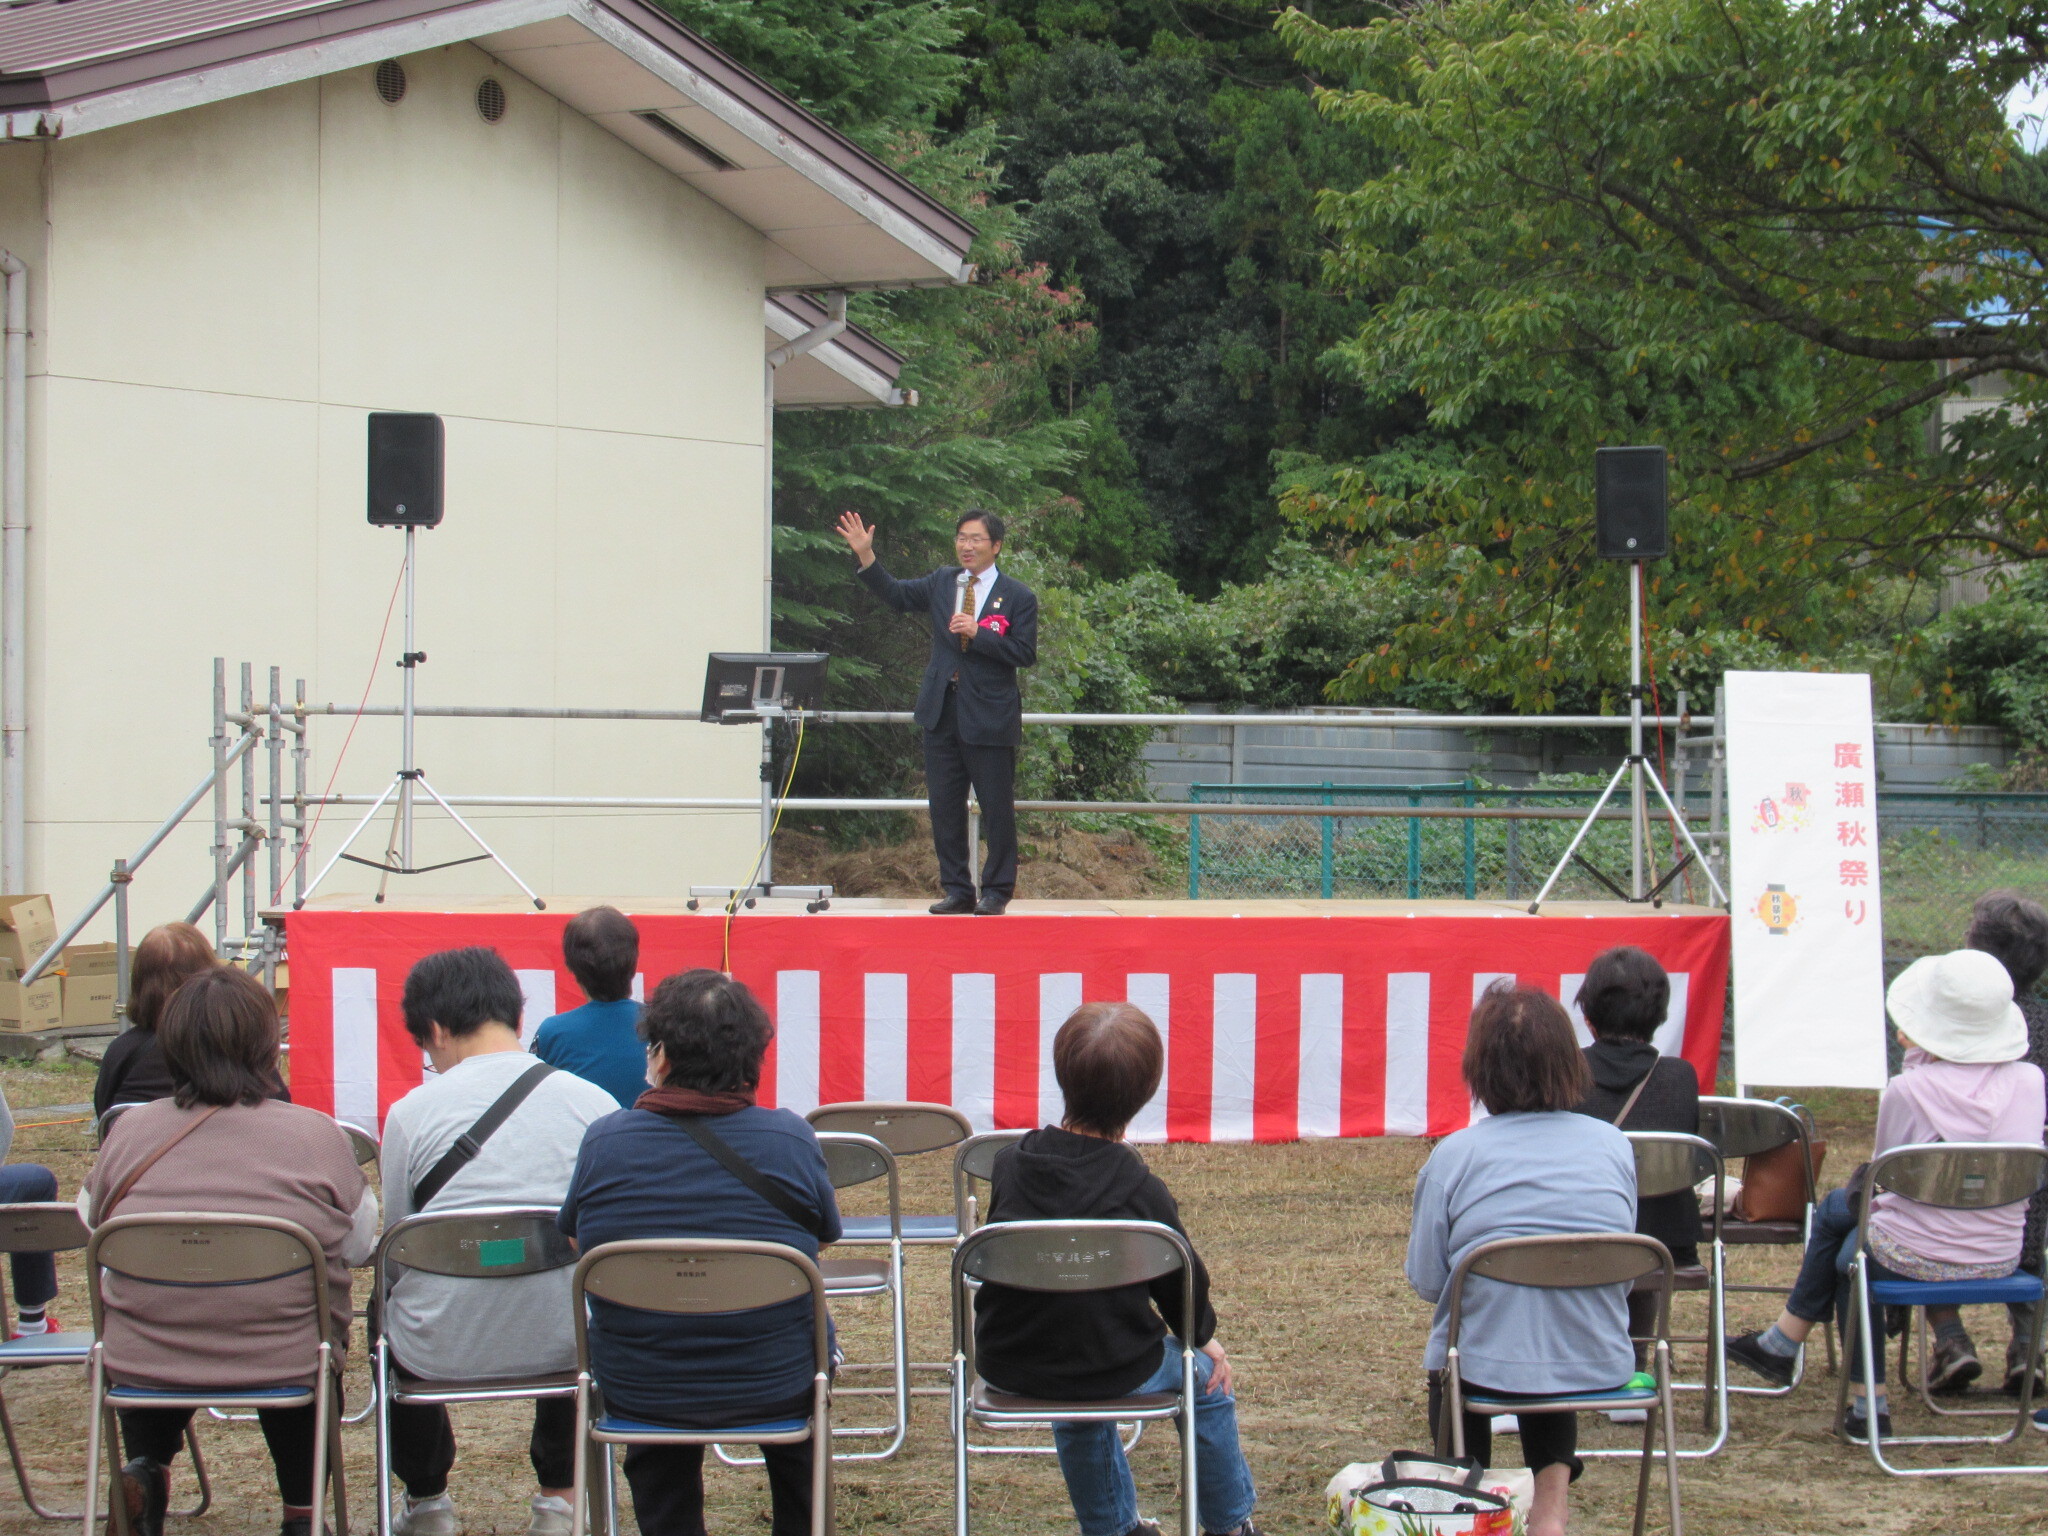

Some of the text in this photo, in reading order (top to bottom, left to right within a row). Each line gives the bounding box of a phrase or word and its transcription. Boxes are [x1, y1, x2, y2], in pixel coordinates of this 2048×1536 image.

[1789, 786, 1803, 802] 秋
[1834, 742, 1868, 926] 廣瀬秋祭り
